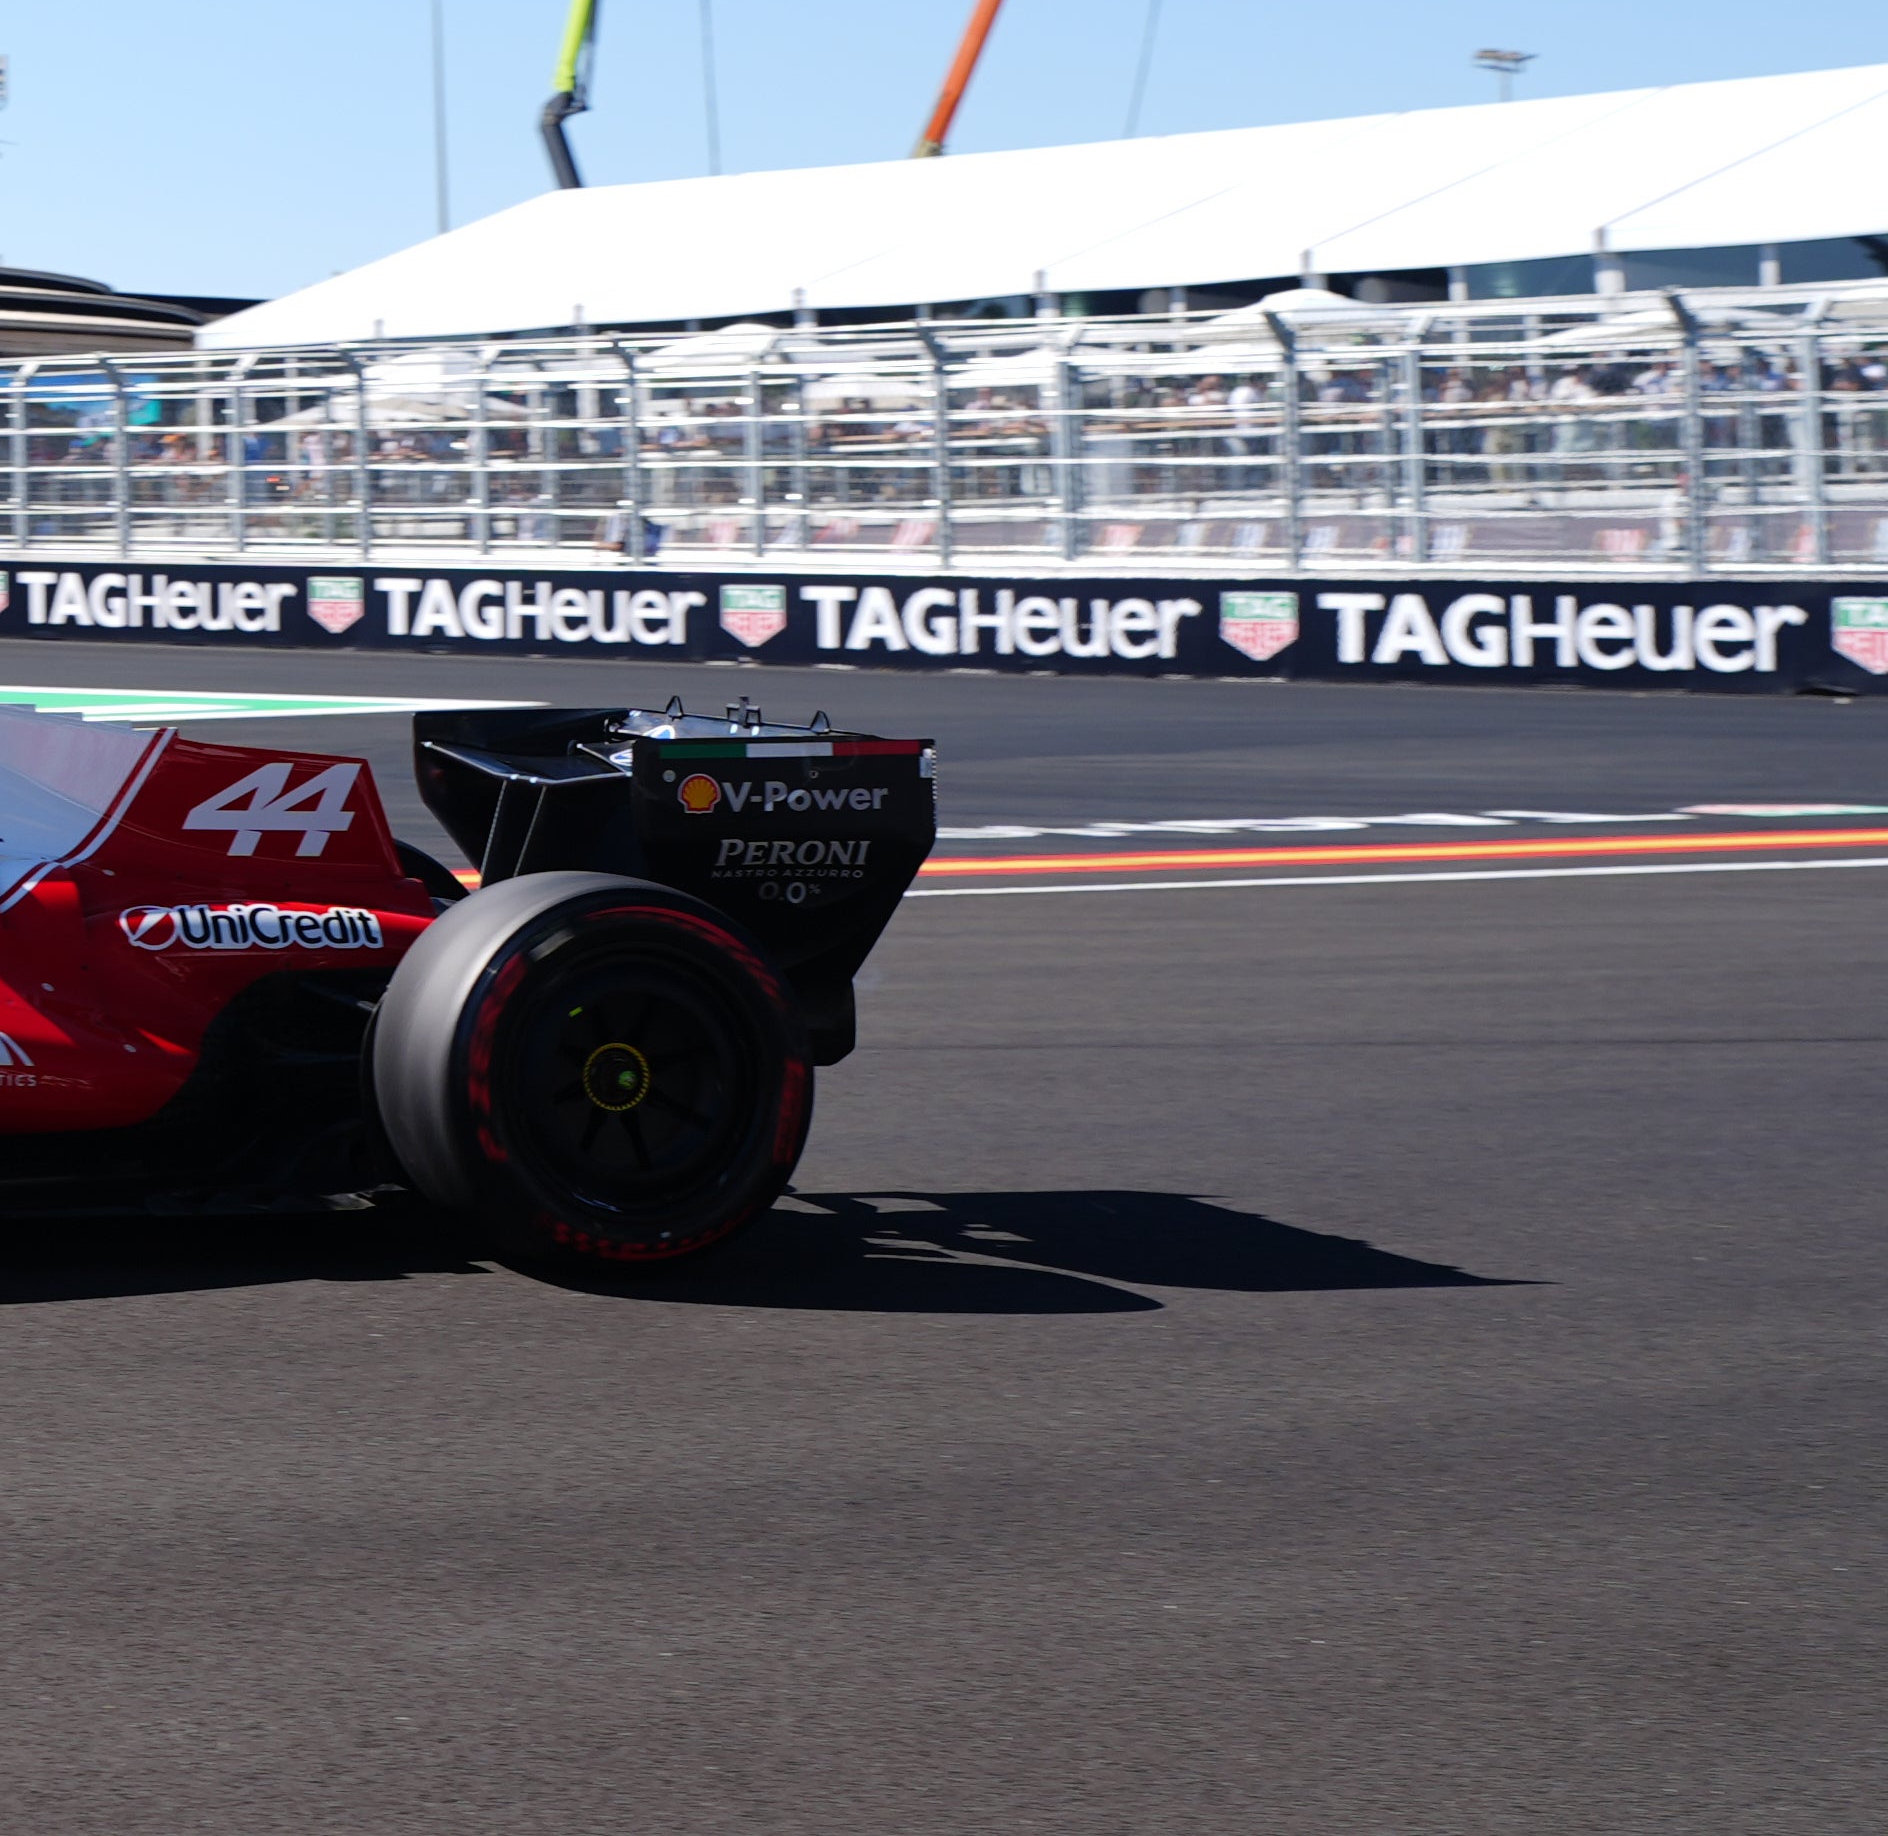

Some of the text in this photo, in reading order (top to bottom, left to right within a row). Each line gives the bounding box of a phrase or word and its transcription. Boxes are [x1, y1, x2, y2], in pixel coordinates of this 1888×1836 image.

[182, 763, 362, 857] 44
[723, 781, 888, 812] V-Power
[715, 838, 871, 866] PERONI
[711, 868, 864, 879] NASTRO AZZURRO
[177, 905, 381, 947] UniCredit
